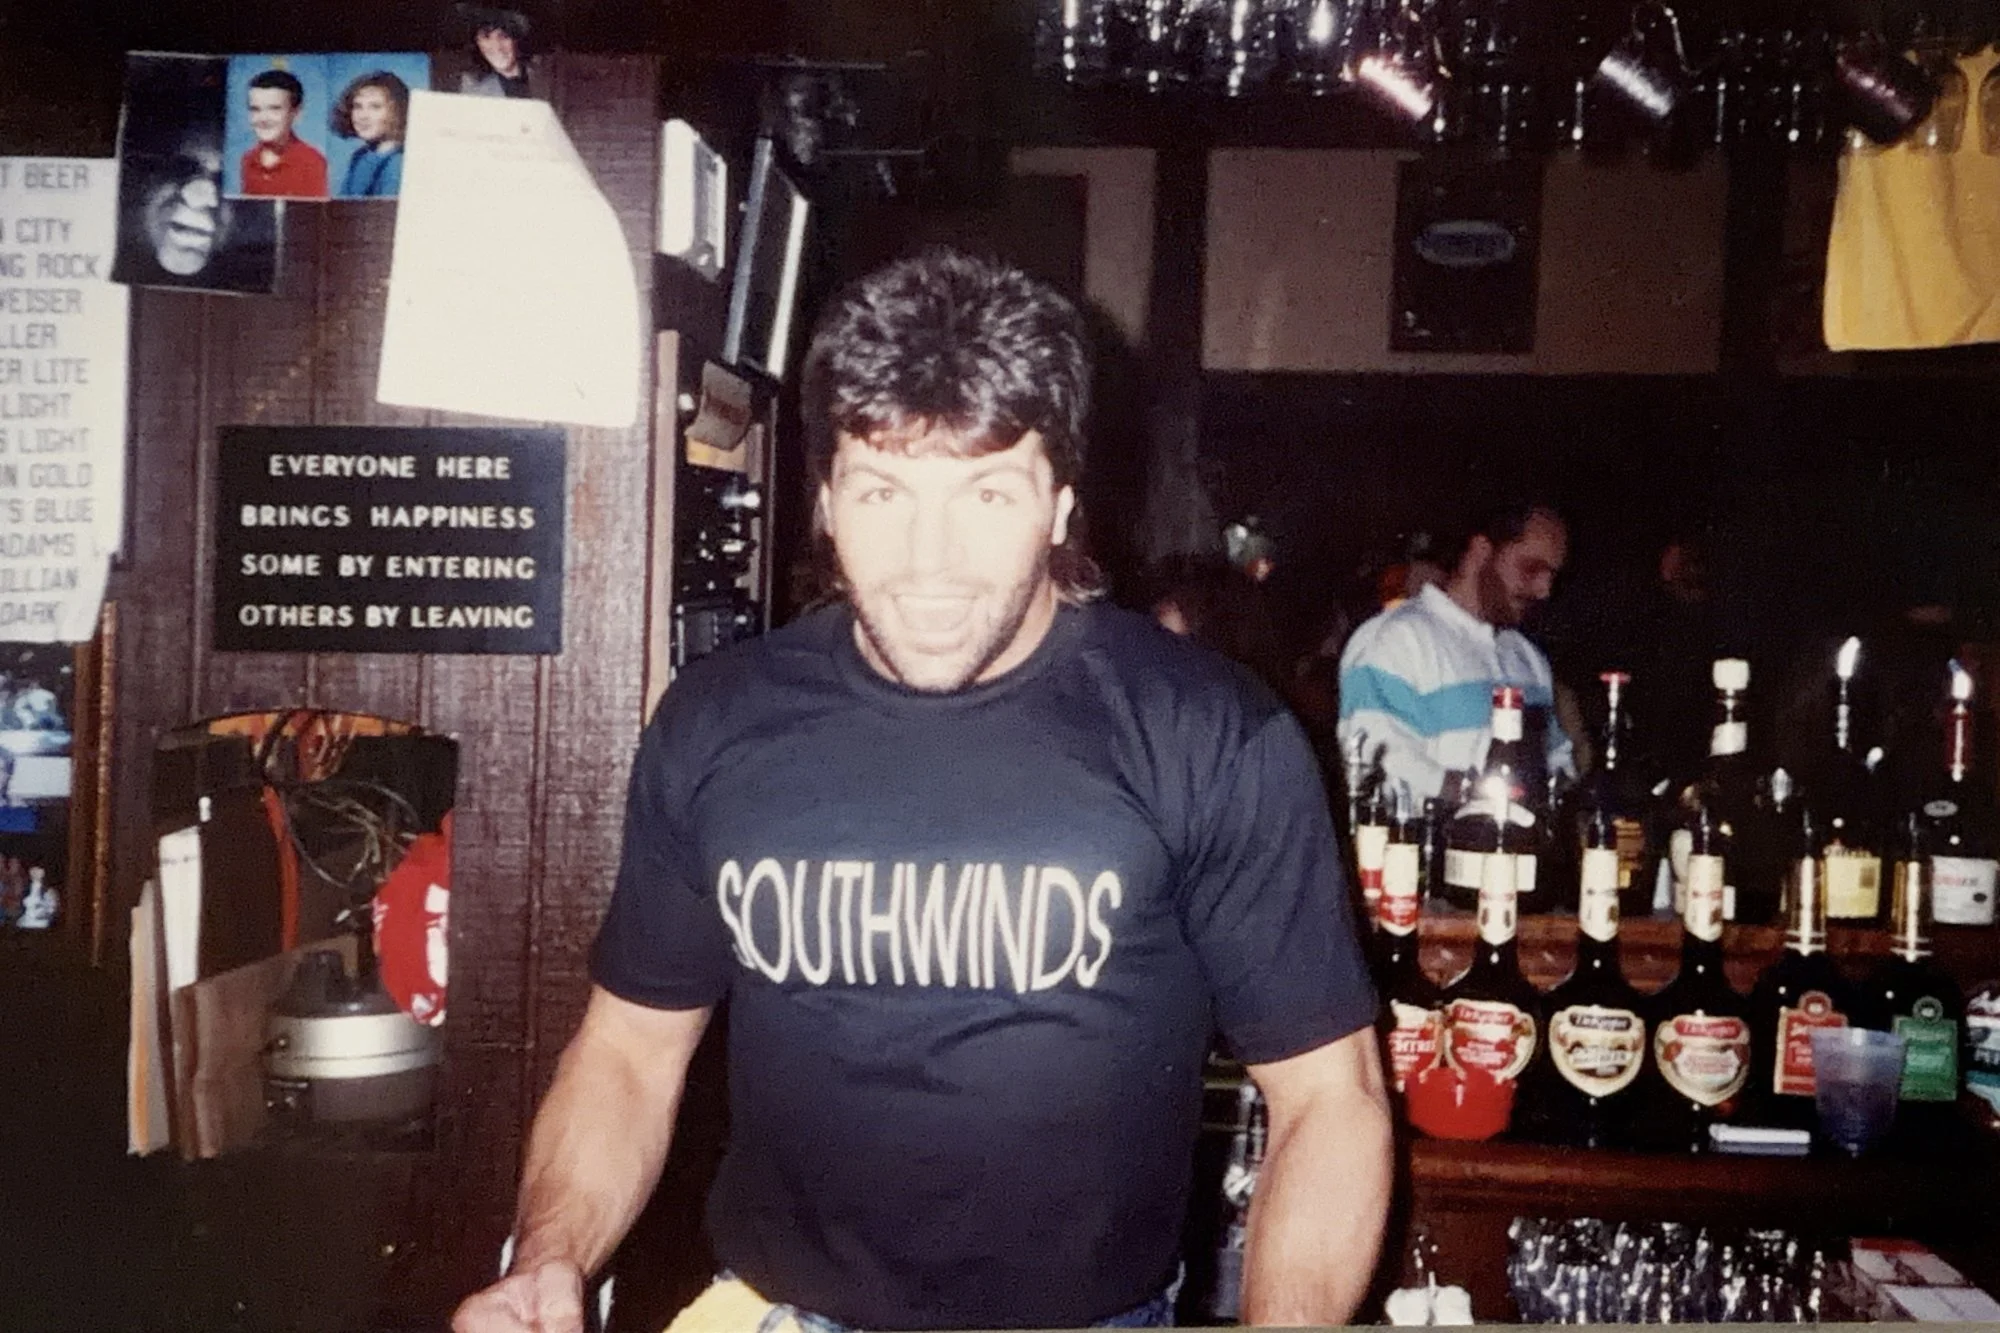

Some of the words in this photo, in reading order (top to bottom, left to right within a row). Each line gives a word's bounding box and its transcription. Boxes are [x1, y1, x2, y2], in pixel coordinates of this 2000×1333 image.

[24, 163, 89, 190] BEER
[16, 218, 72, 244] CITY
[37, 253, 99, 280] ROCK
[33, 357, 90, 385] LITE
[1, 392, 71, 420] LIGHT
[18, 429, 90, 455] LIGHT
[30, 463, 93, 489] GOLD
[269, 455, 416, 479] EVERYONE
[436, 456, 511, 480] HERE
[35, 498, 94, 524] BLUE
[370, 506, 537, 530] HAPPINESS
[240, 553, 321, 577] SOME
[338, 554, 374, 578] BY
[386, 555, 537, 580] ENTERING
[238, 604, 354, 628] OTHERS
[365, 605, 400, 629] BY
[410, 605, 535, 630] LEAVING
[717, 857, 1123, 995] SOUTHWINDS
